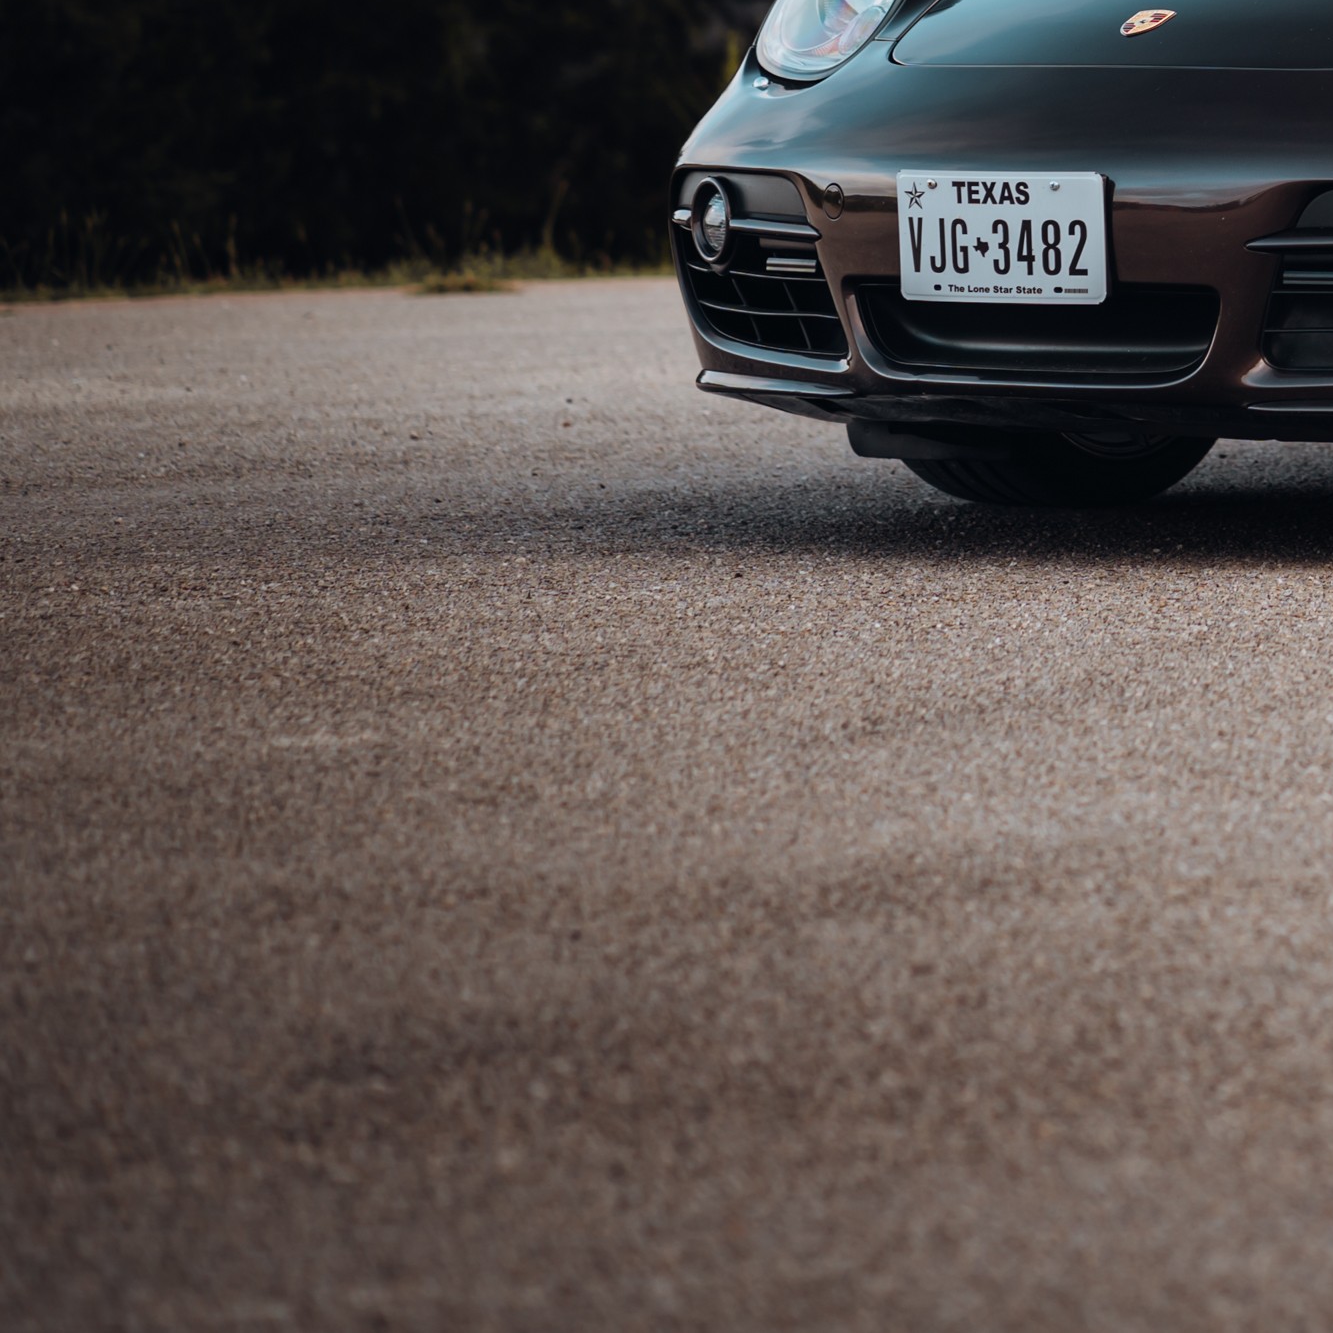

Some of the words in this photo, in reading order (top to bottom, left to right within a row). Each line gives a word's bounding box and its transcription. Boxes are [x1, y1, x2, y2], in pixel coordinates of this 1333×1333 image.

[951, 180, 1030, 206] TEXAS
[907, 216, 970, 275] VJG
[991, 218, 1089, 277] 3482
[947, 284, 965, 293] The
[967, 284, 990, 294] Lone
[992, 285, 1014, 295] Star
[1015, 285, 1043, 295] State
